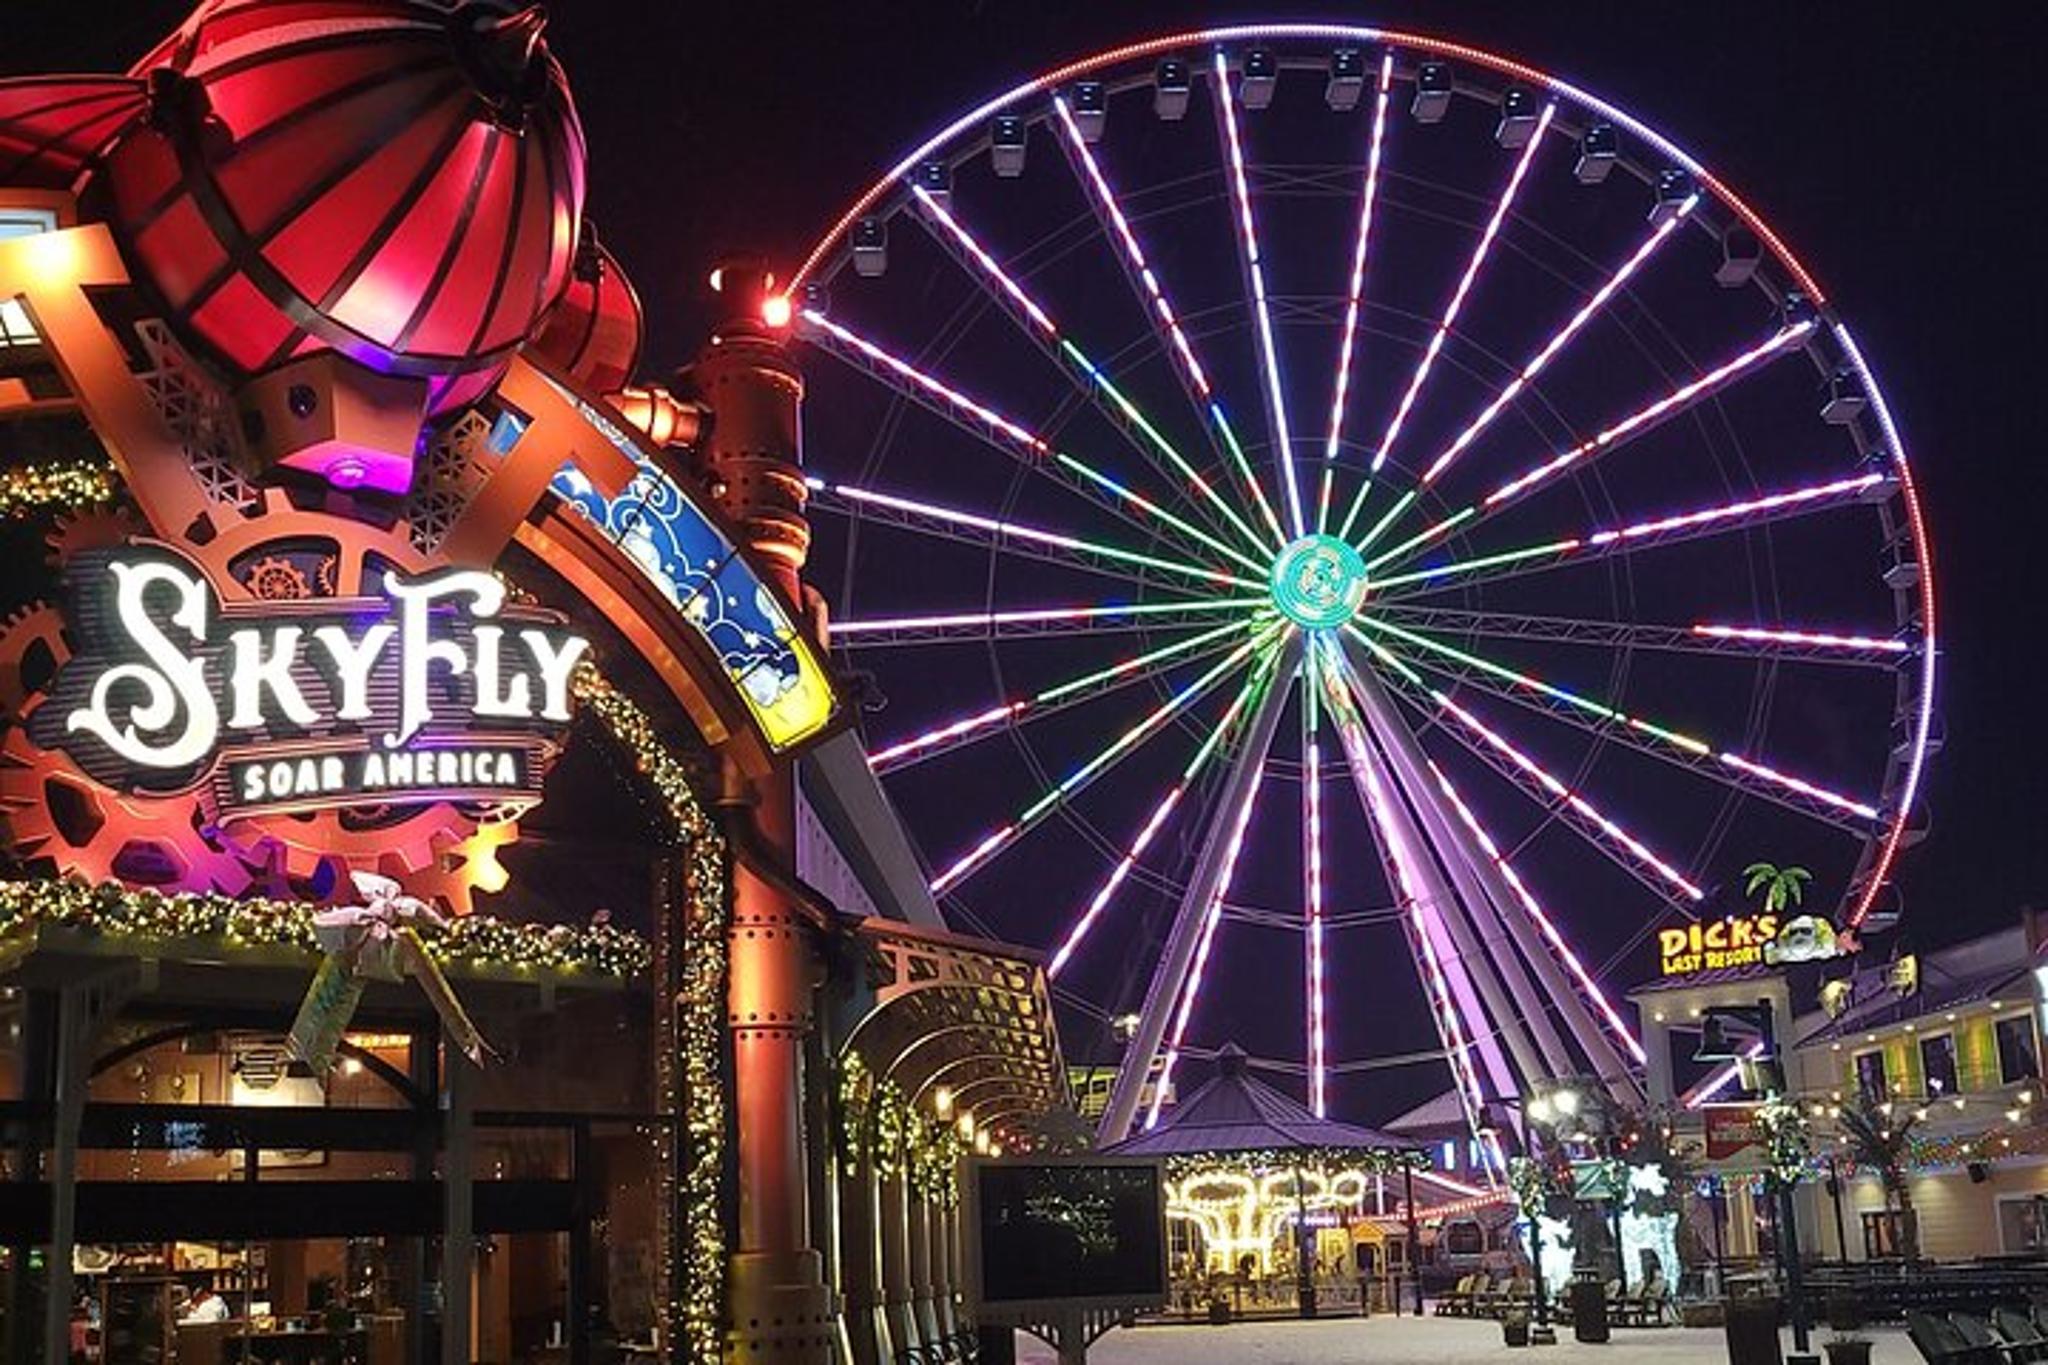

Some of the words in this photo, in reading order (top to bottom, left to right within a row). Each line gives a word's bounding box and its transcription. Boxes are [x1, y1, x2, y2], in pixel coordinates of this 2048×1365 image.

[67, 562, 590, 768] SKYFLY
[244, 758, 344, 800] SOAR
[363, 752, 517, 787] AMERICA
[1659, 914, 1778, 957] DICK'S
[1662, 954, 1702, 975] LAST
